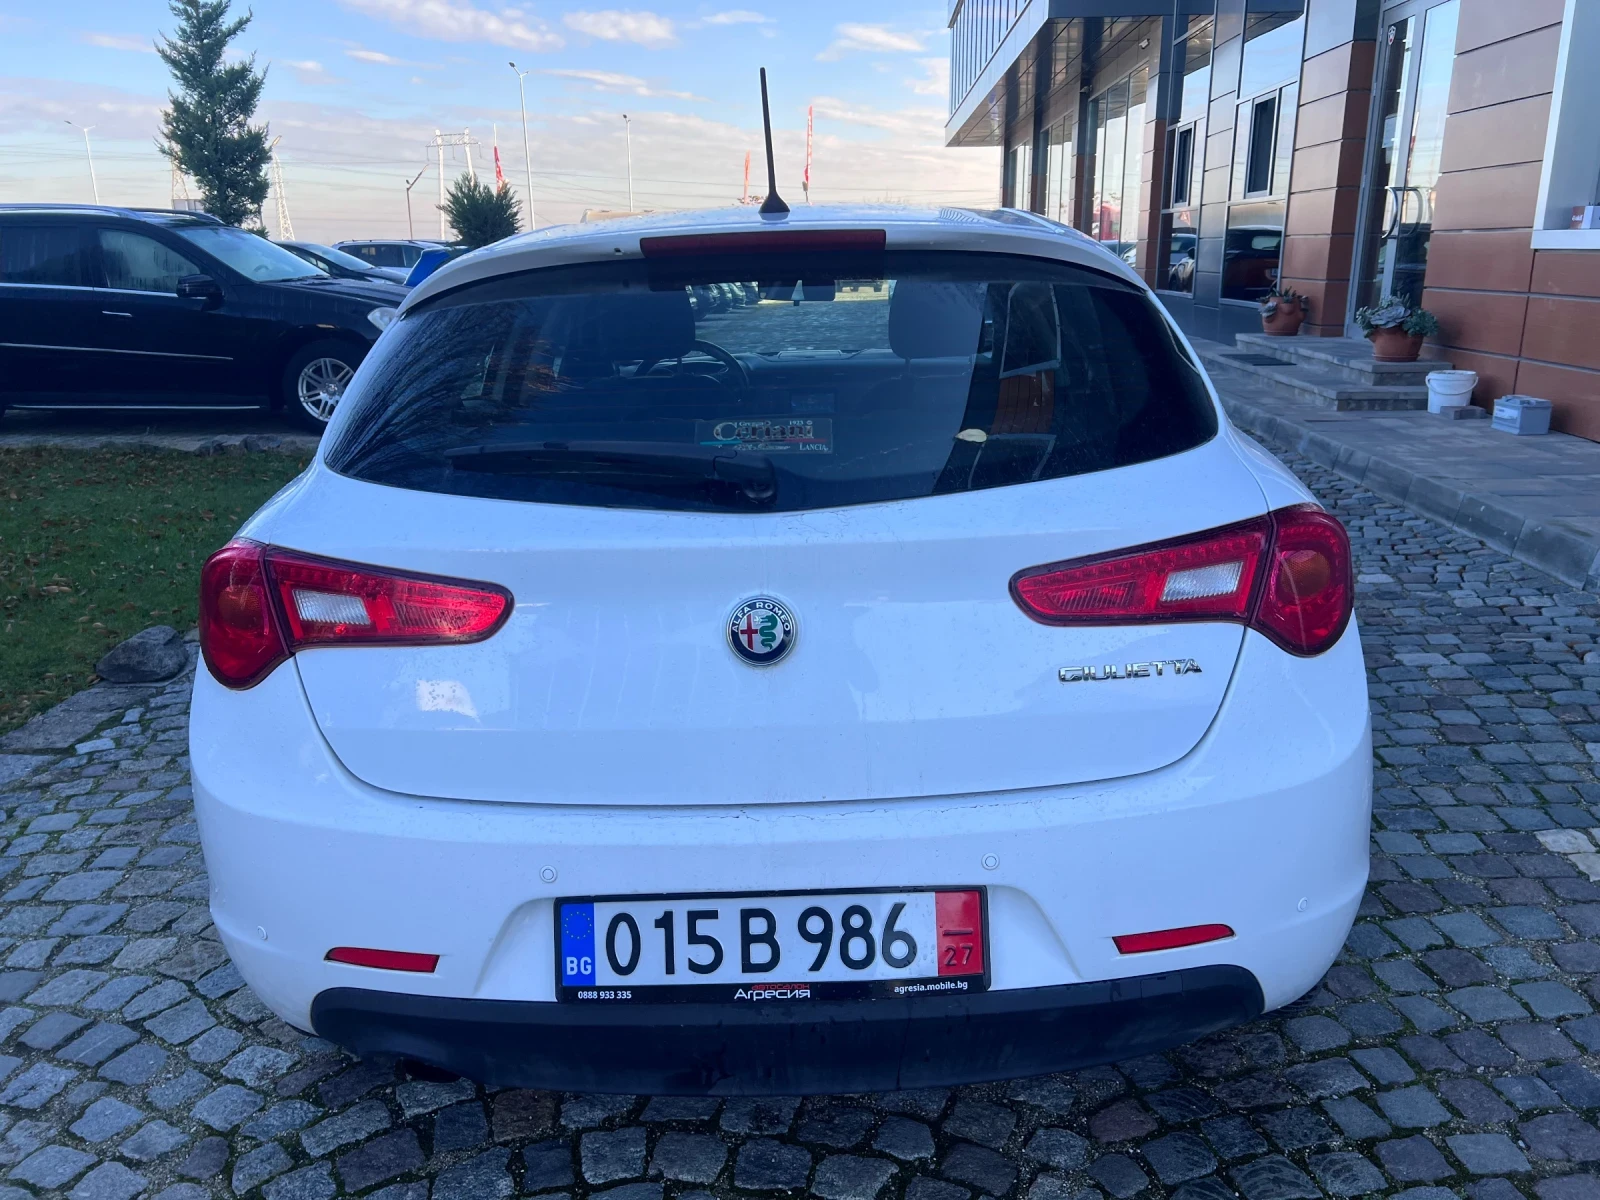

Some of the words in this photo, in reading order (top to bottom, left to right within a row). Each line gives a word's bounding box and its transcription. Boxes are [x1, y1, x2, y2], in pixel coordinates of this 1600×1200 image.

[713, 420, 815, 440] Ceriani
[799, 442, 827, 450] LANCIA
[732, 606, 751, 632] ALFA
[756, 602, 790, 631] ROMEO
[1058, 658, 1202, 682] GIULIETTA
[944, 943, 973, 966] 27
[566, 956, 592, 975] BG
[577, 991, 598, 999] 0888
[600, 990, 615, 999] 933
[616, 990, 632, 999] 335
[734, 988, 811, 1001] Агресия
[894, 981, 968, 994] agresia.mobile.bg
